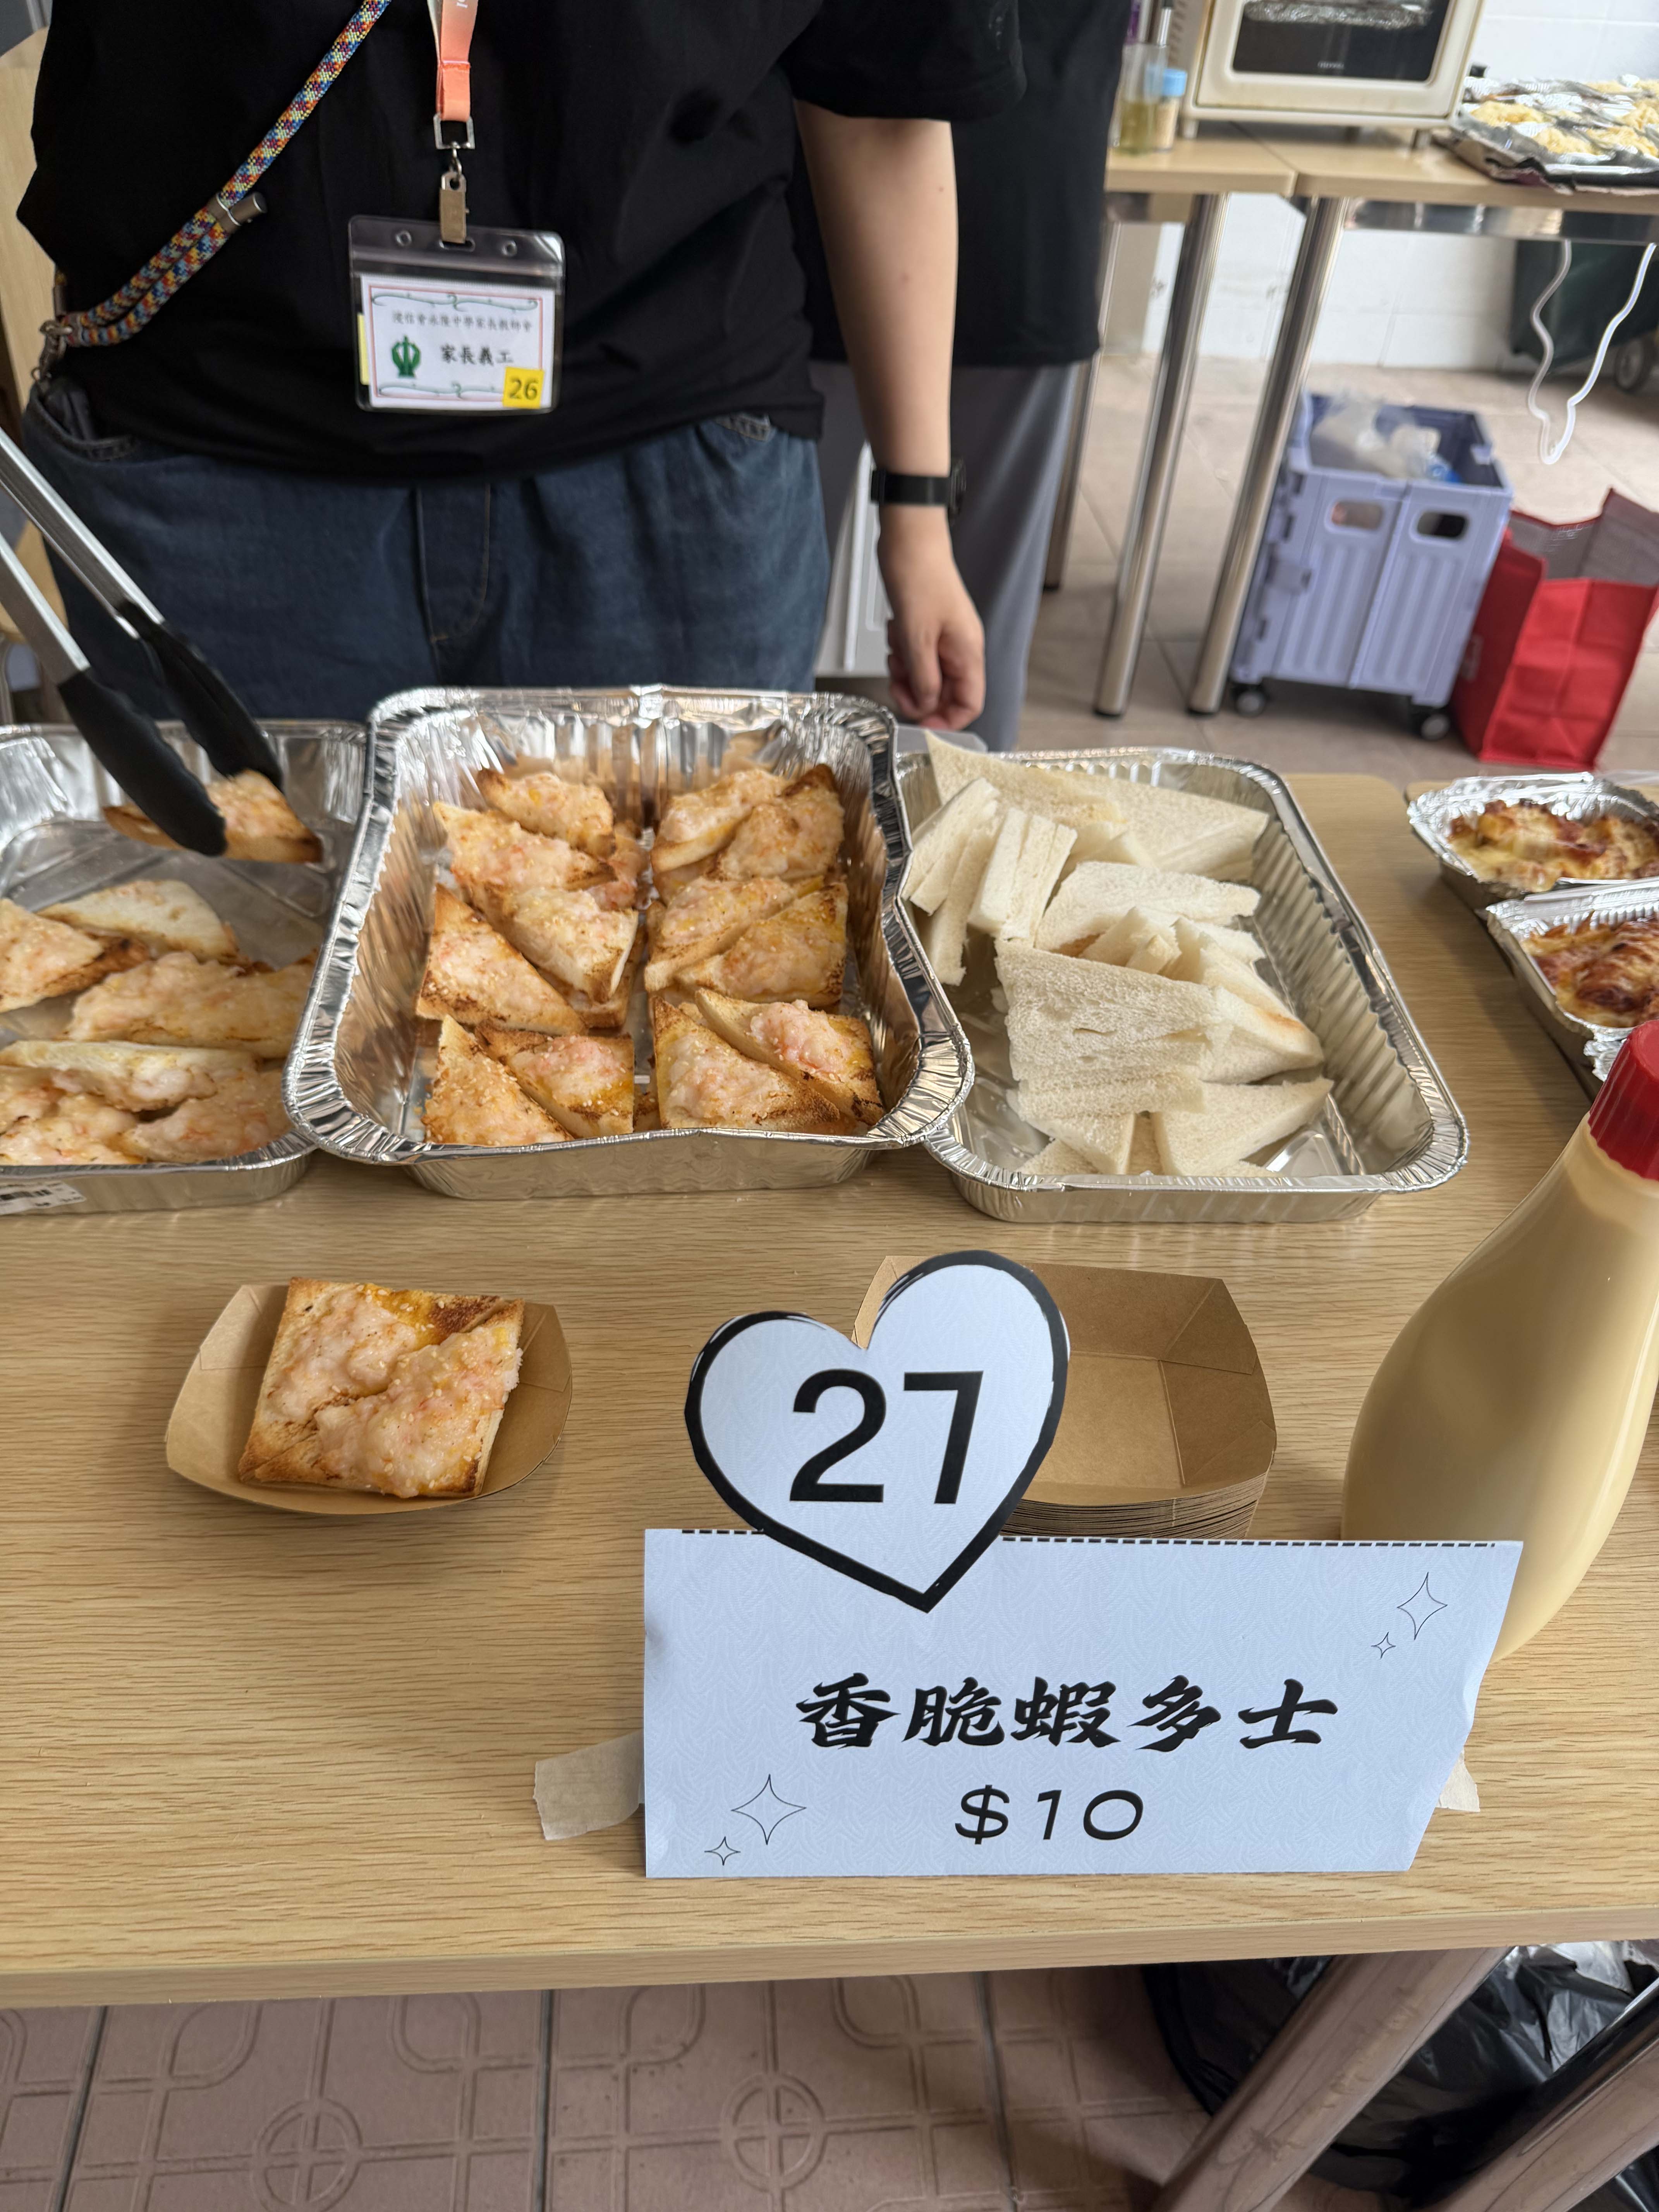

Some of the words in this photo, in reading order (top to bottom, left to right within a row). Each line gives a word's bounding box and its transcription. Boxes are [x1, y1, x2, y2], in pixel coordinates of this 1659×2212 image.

[441, 343, 514, 366] 家長義工
[509, 378, 538, 400] 26
[789, 1369, 984, 1504] 27
[796, 1672, 1338, 1752] 香脆蝦多士
[955, 1784, 1144, 1845] $10
